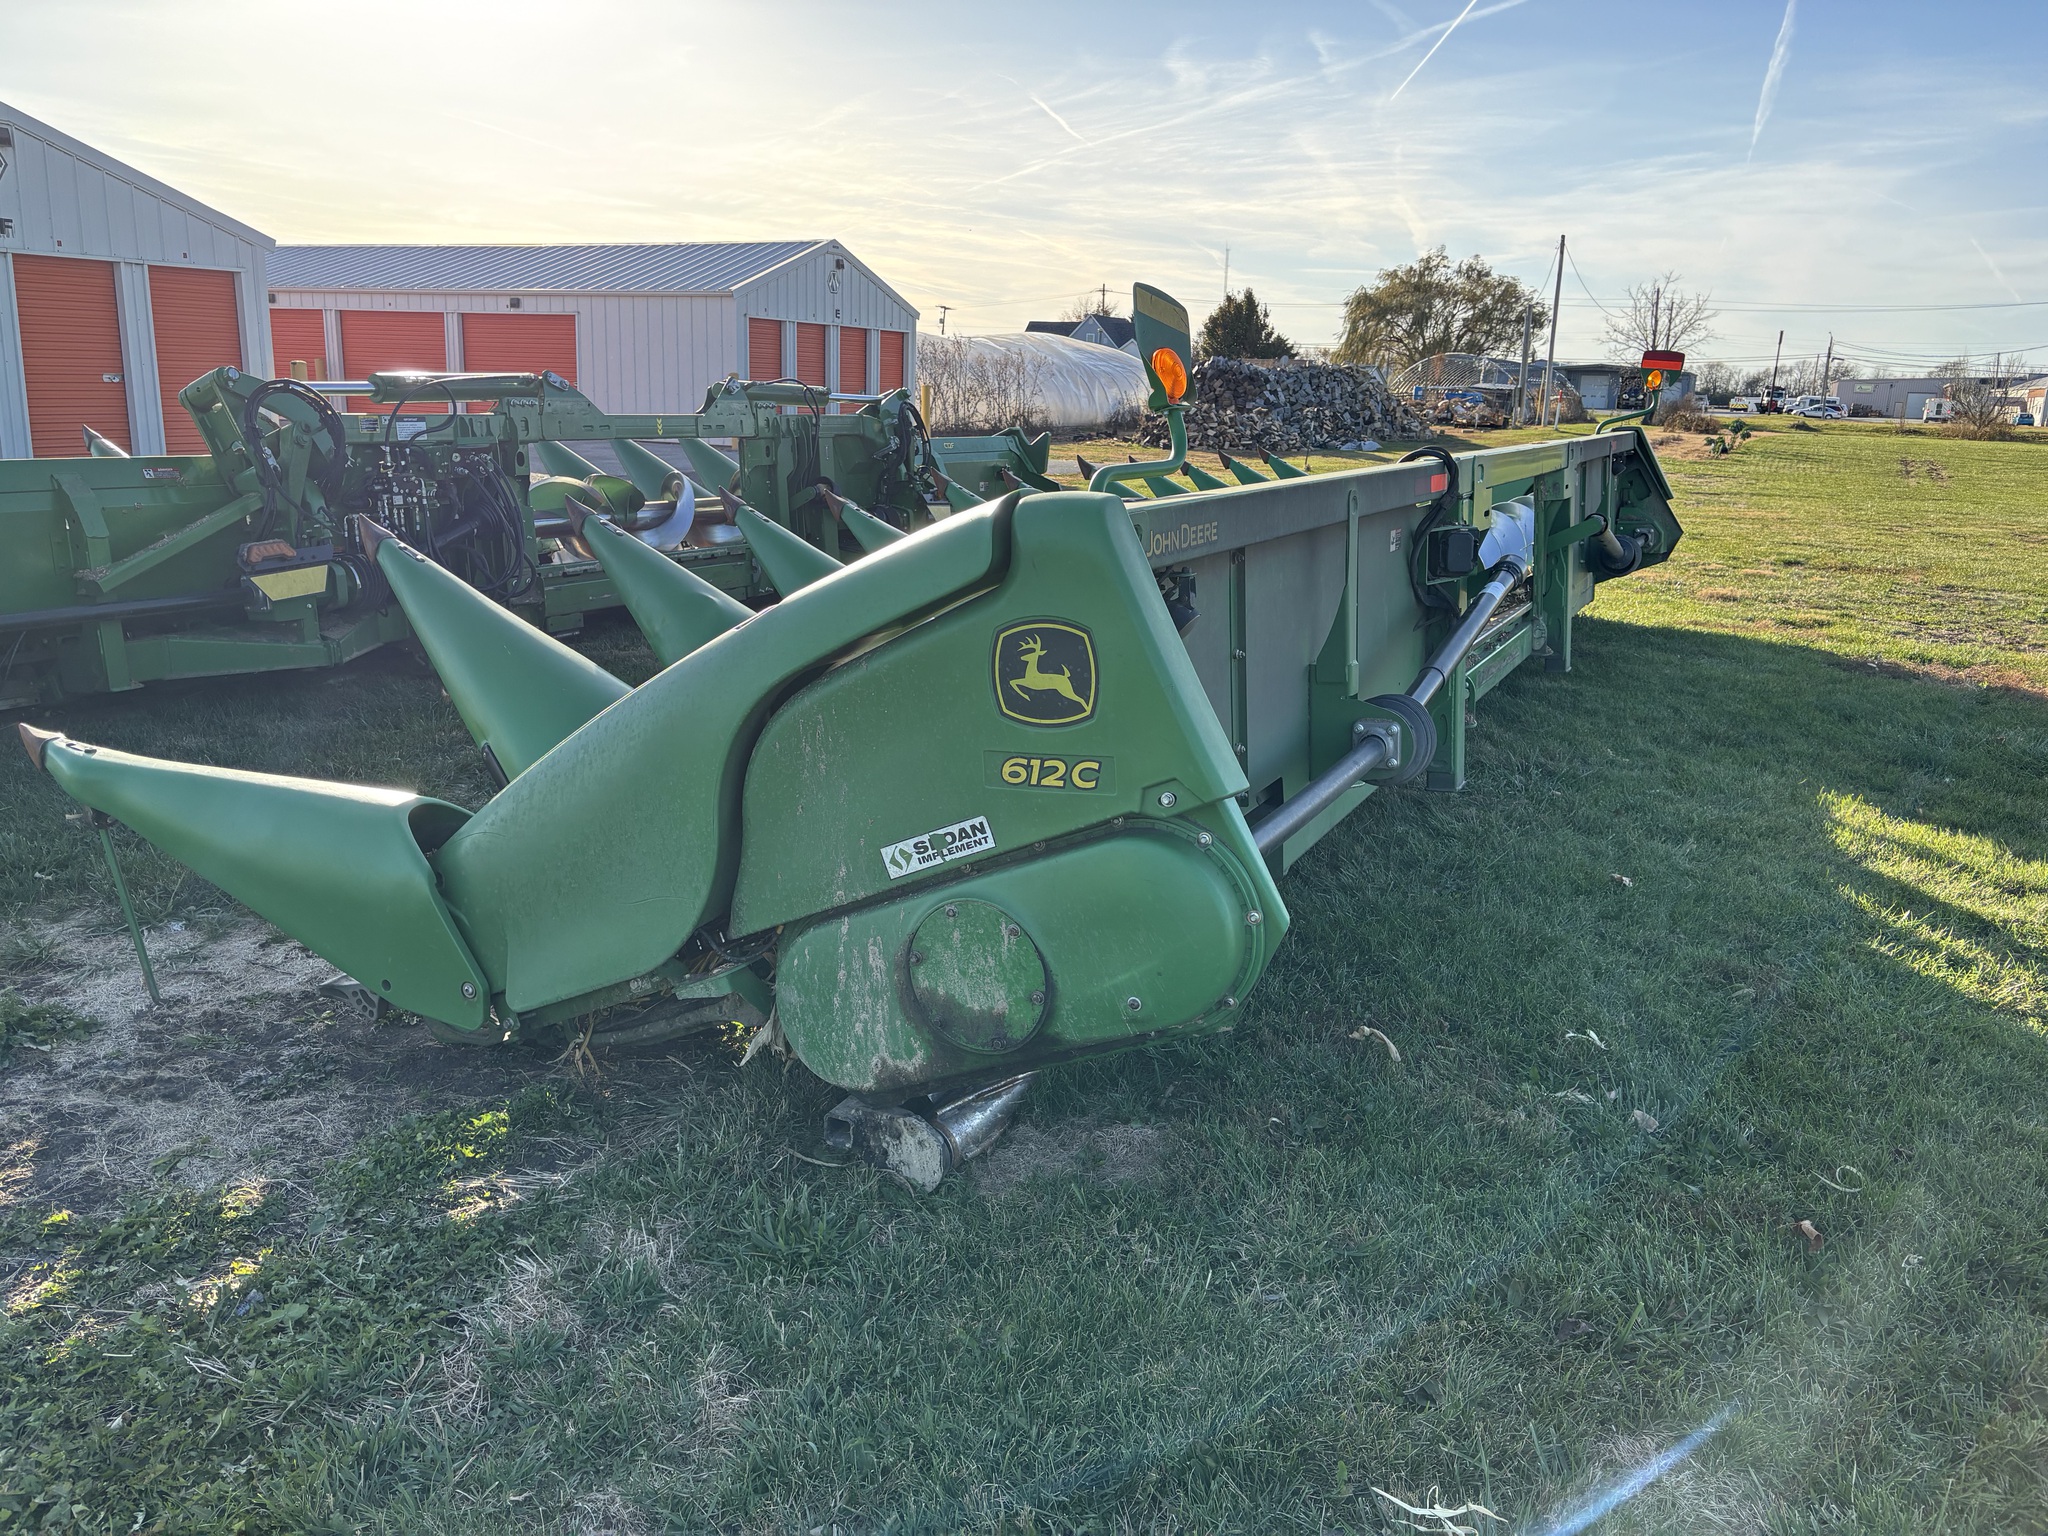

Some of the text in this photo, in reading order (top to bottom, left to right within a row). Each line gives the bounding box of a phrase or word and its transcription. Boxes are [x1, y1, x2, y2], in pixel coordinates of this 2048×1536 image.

[1146, 521, 1218, 558] JOHN DEERE
[1001, 756, 1101, 790] 612C
[917, 835, 989, 865] IMPLEMENT
